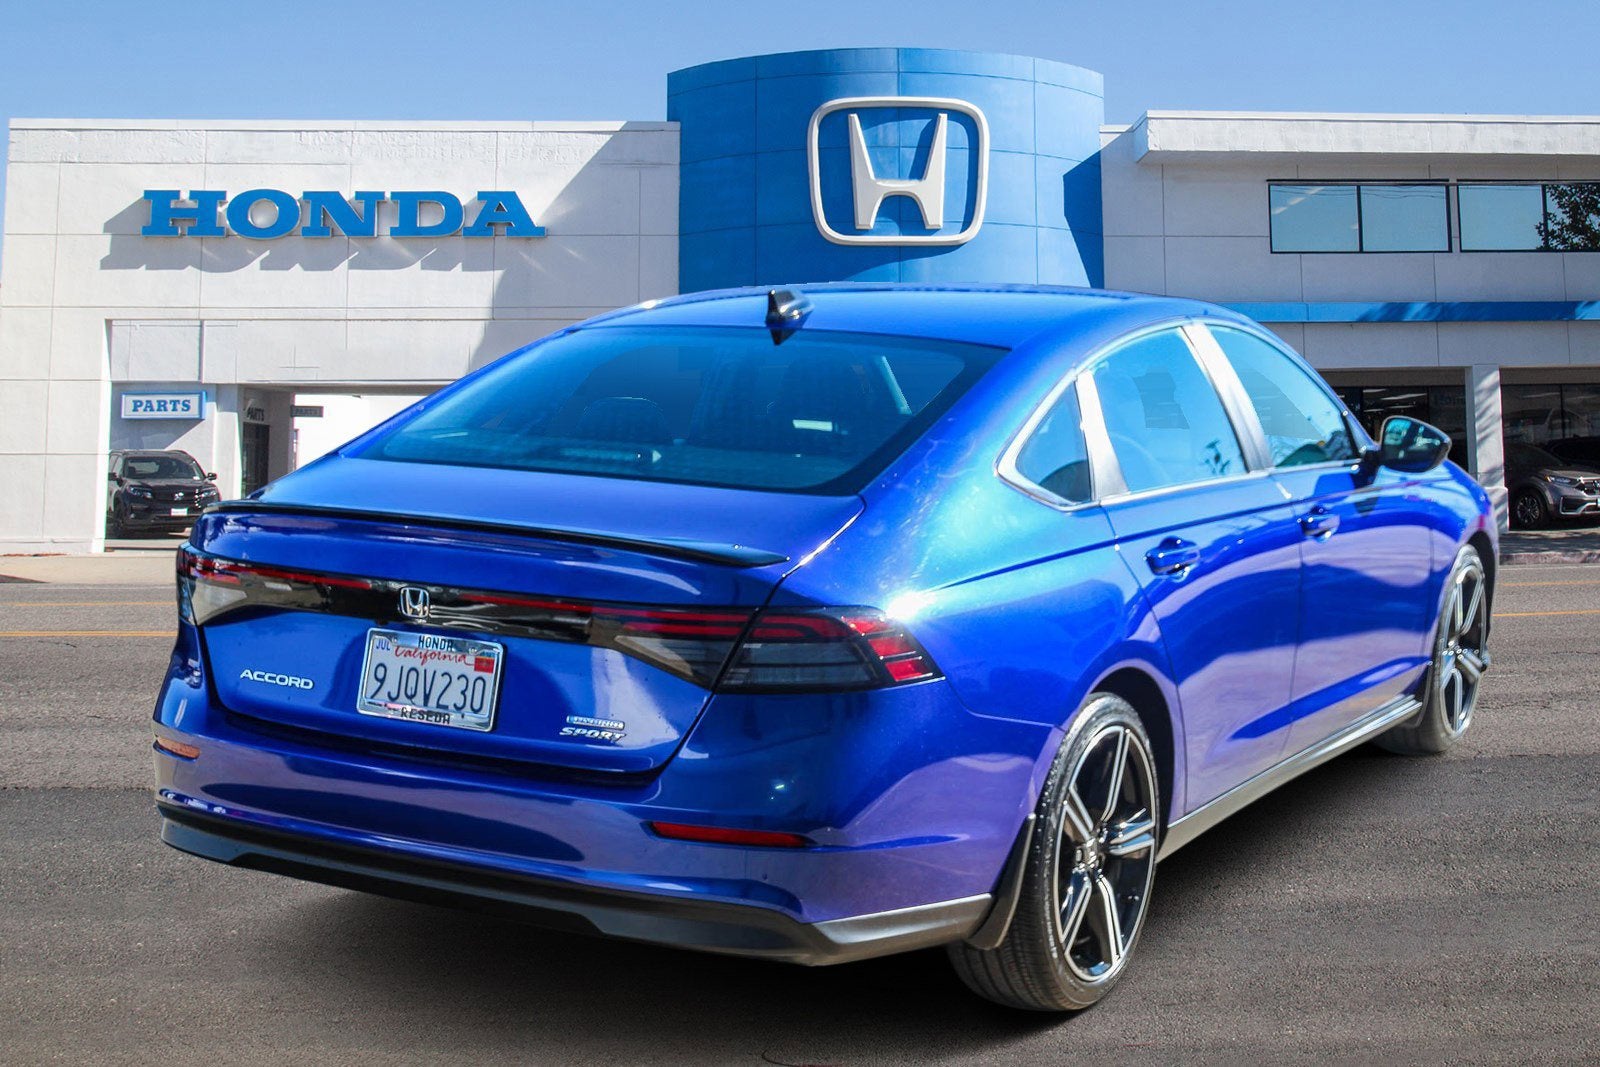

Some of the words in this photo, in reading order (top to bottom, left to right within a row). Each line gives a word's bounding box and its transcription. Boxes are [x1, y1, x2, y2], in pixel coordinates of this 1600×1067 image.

[141, 189, 548, 240] HONDA
[132, 400, 191, 412] PARTS
[375, 639, 391, 651] JUL
[418, 635, 454, 651] HONDA
[394, 645, 474, 666] California
[240, 669, 314, 690] ACCORD
[370, 663, 487, 714] 9JQV230
[400, 706, 451, 725] RESEDA
[559, 727, 628, 742] SPORT
